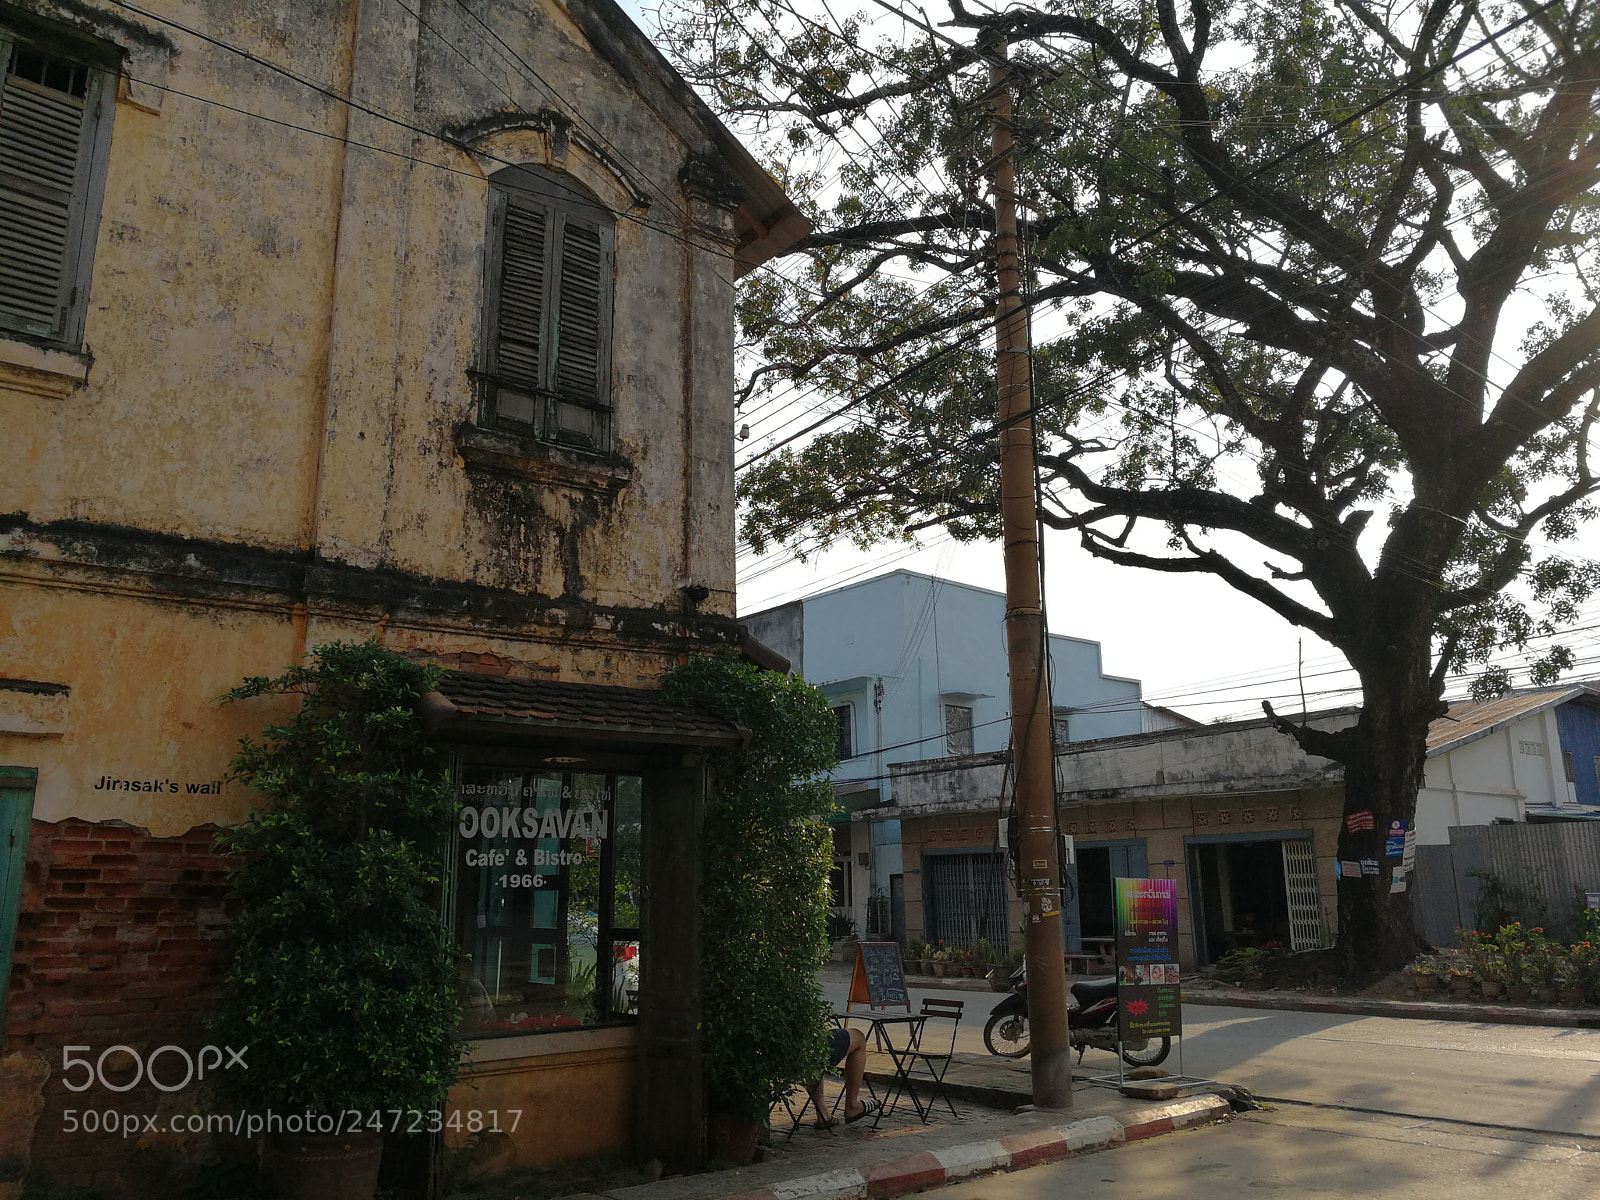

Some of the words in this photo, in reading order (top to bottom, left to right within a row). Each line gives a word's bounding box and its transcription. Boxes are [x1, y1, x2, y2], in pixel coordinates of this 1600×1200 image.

[94, 776, 179, 793] Jirasak's
[185, 780, 222, 795] wall
[562, 785, 571, 799] &
[515, 849, 528, 866] &
[533, 849, 583, 866] Bistro
